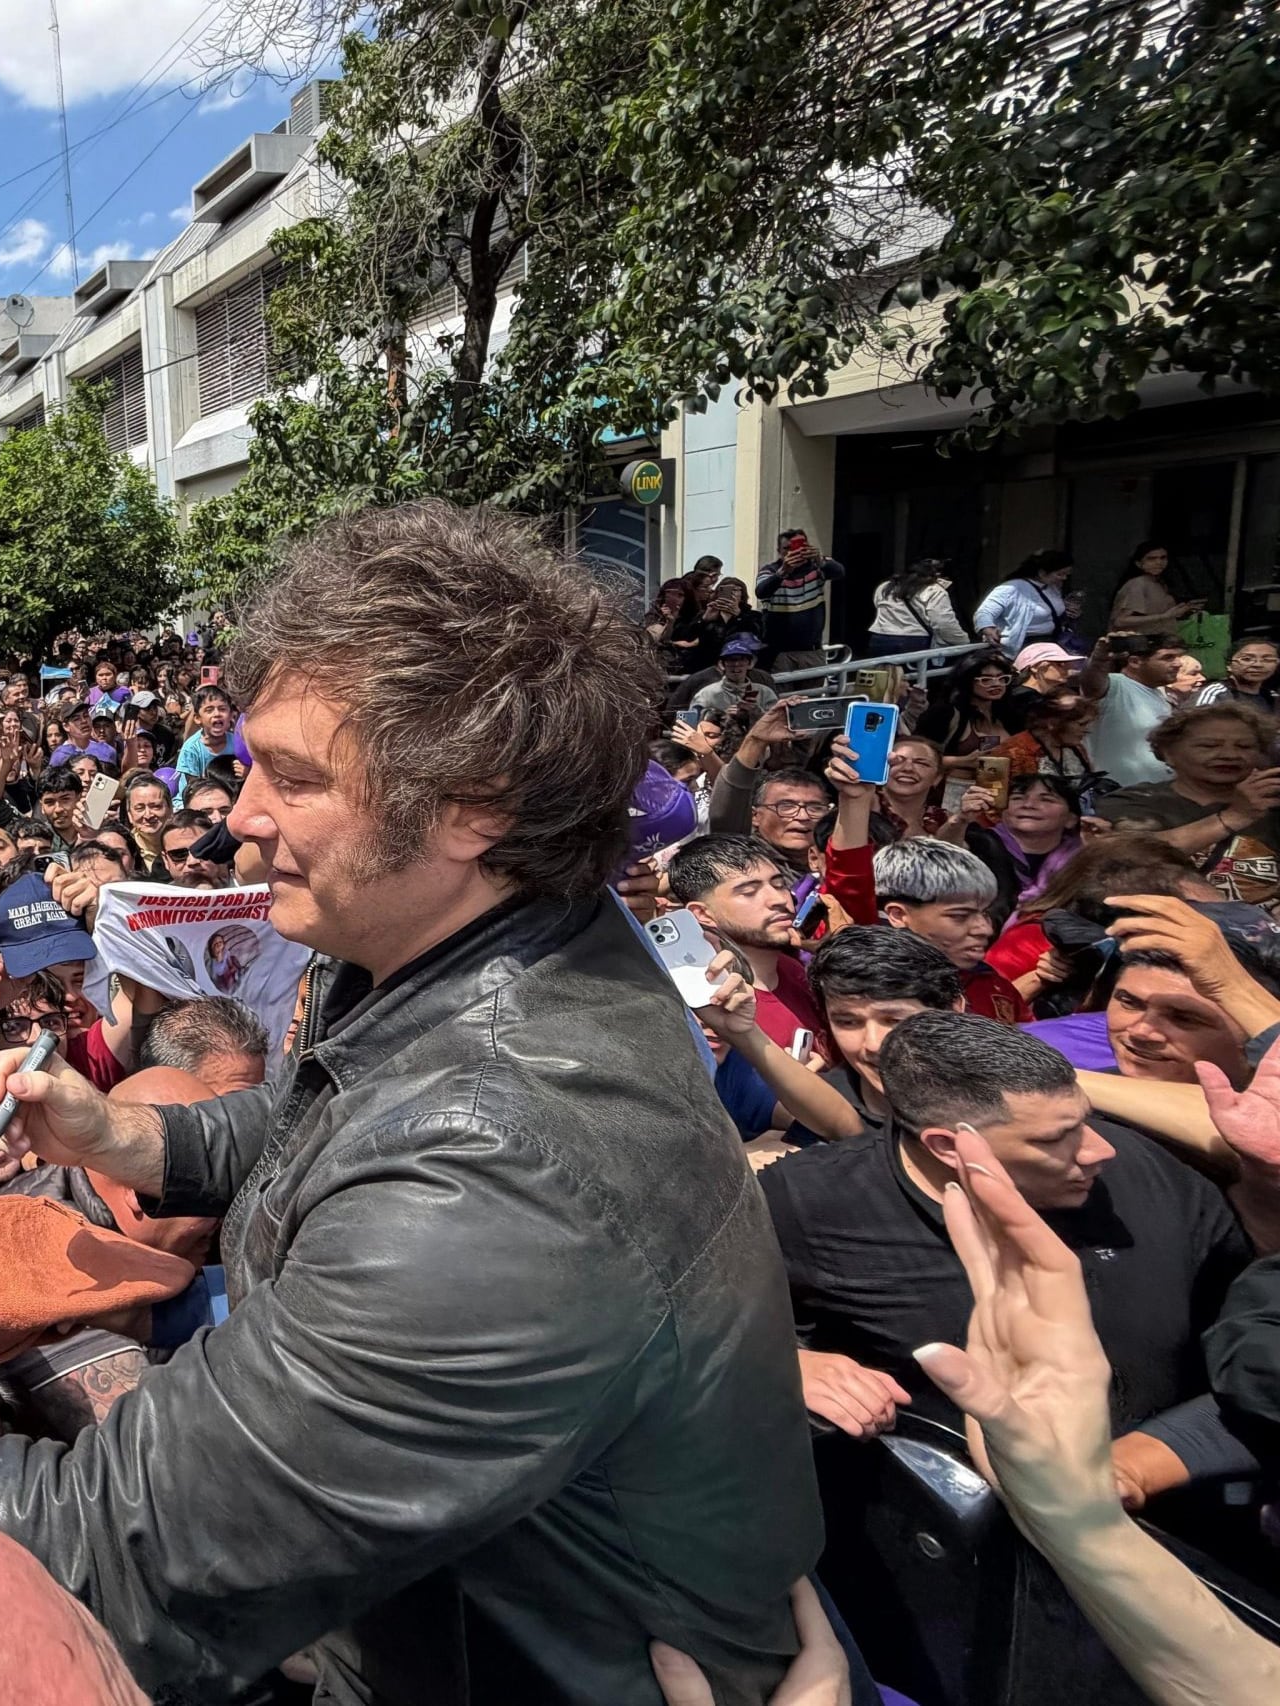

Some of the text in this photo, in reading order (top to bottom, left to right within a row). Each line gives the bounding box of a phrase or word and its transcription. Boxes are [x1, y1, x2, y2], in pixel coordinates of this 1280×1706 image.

[636, 473, 662, 490] LINK
[137, 895, 213, 907] JUSTICIA
[213, 893, 245, 907] POR
[7, 905, 29, 919] MAKE
[13, 913, 42, 930] GREAT
